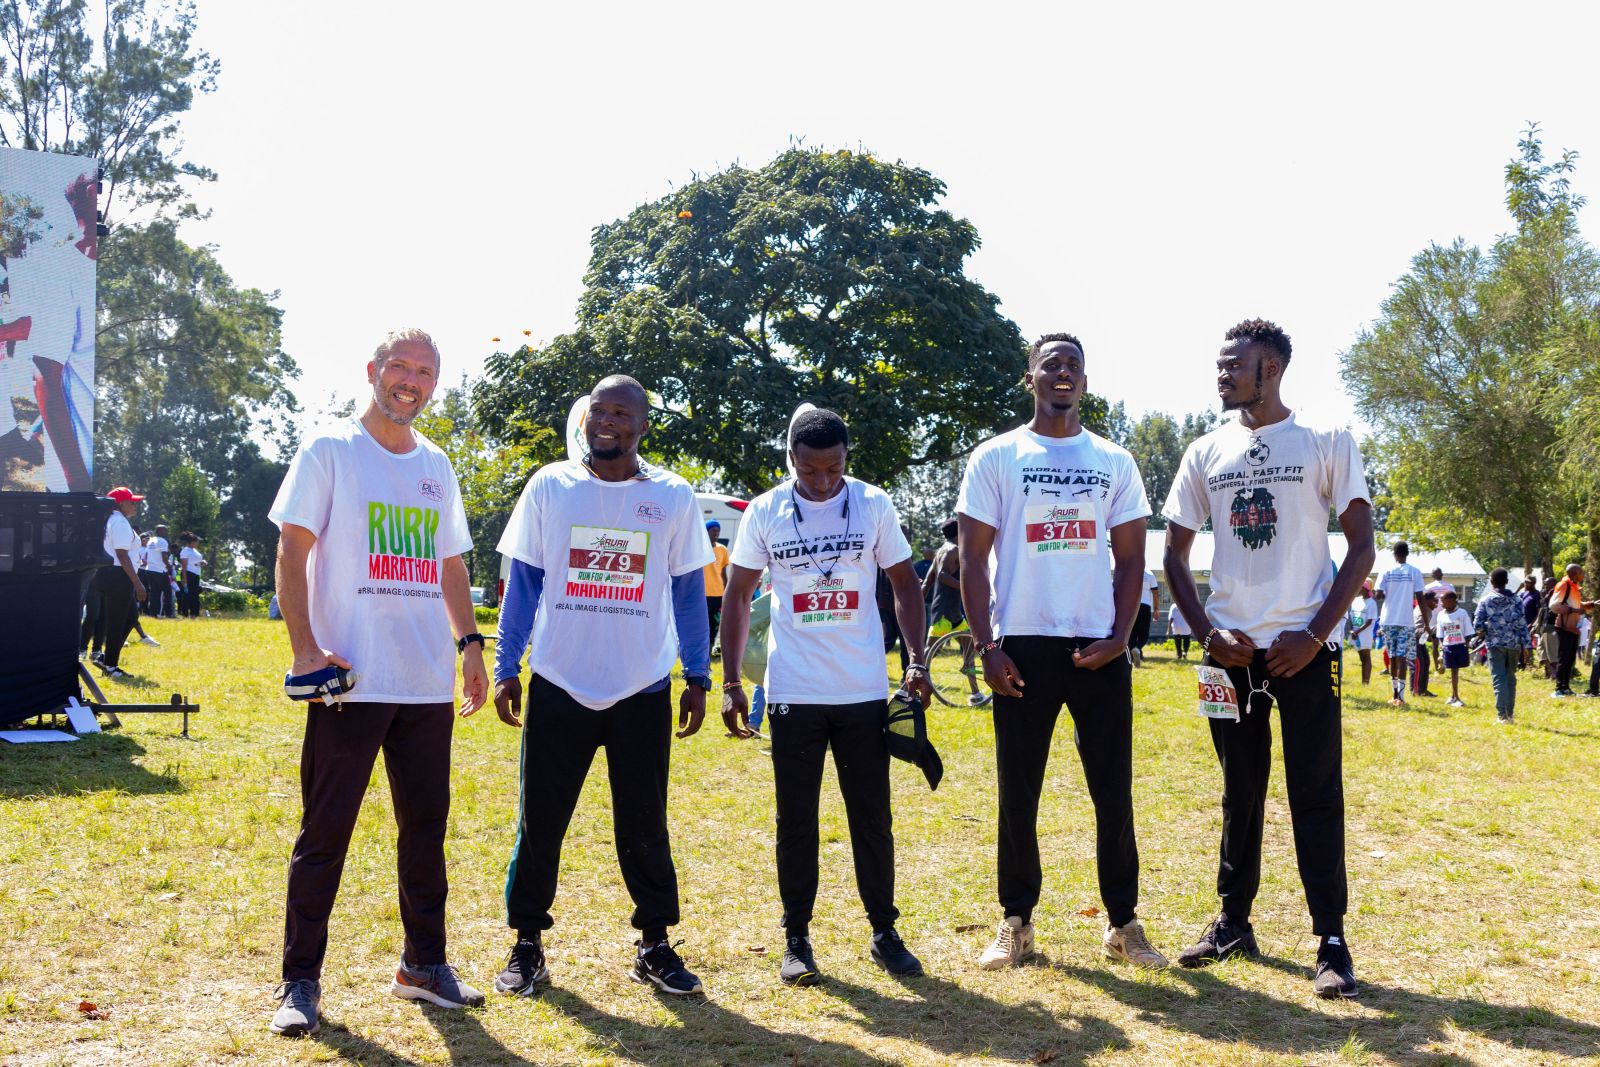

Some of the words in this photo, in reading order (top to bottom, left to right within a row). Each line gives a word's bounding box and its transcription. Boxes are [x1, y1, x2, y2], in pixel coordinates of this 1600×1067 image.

[1023, 474, 1111, 489] NOMADS
[1208, 471, 1250, 485] GLOBAL
[1253, 467, 1282, 477] FAST
[1284, 466, 1304, 474] FIT
[1043, 521, 1081, 540] 371
[771, 539, 810, 549] GLOBAL
[814, 534, 843, 542] FAST
[1037, 543, 1049, 552] RUN
[1049, 541, 1061, 551] FOR
[772, 541, 865, 560] NOMADS
[369, 554, 438, 584] MARATHON
[587, 551, 631, 572] 279
[578, 571, 591, 581] RUN
[591, 572, 603, 581] FOR
[377, 587, 402, 596] IMAGE
[807, 592, 848, 611] 379
[575, 604, 598, 613] IMAGE
[599, 606, 635, 616] LOGISTICS
[802, 613, 813, 623] RUN
[813, 613, 825, 622] FOR
[1204, 685, 1233, 703] 391
